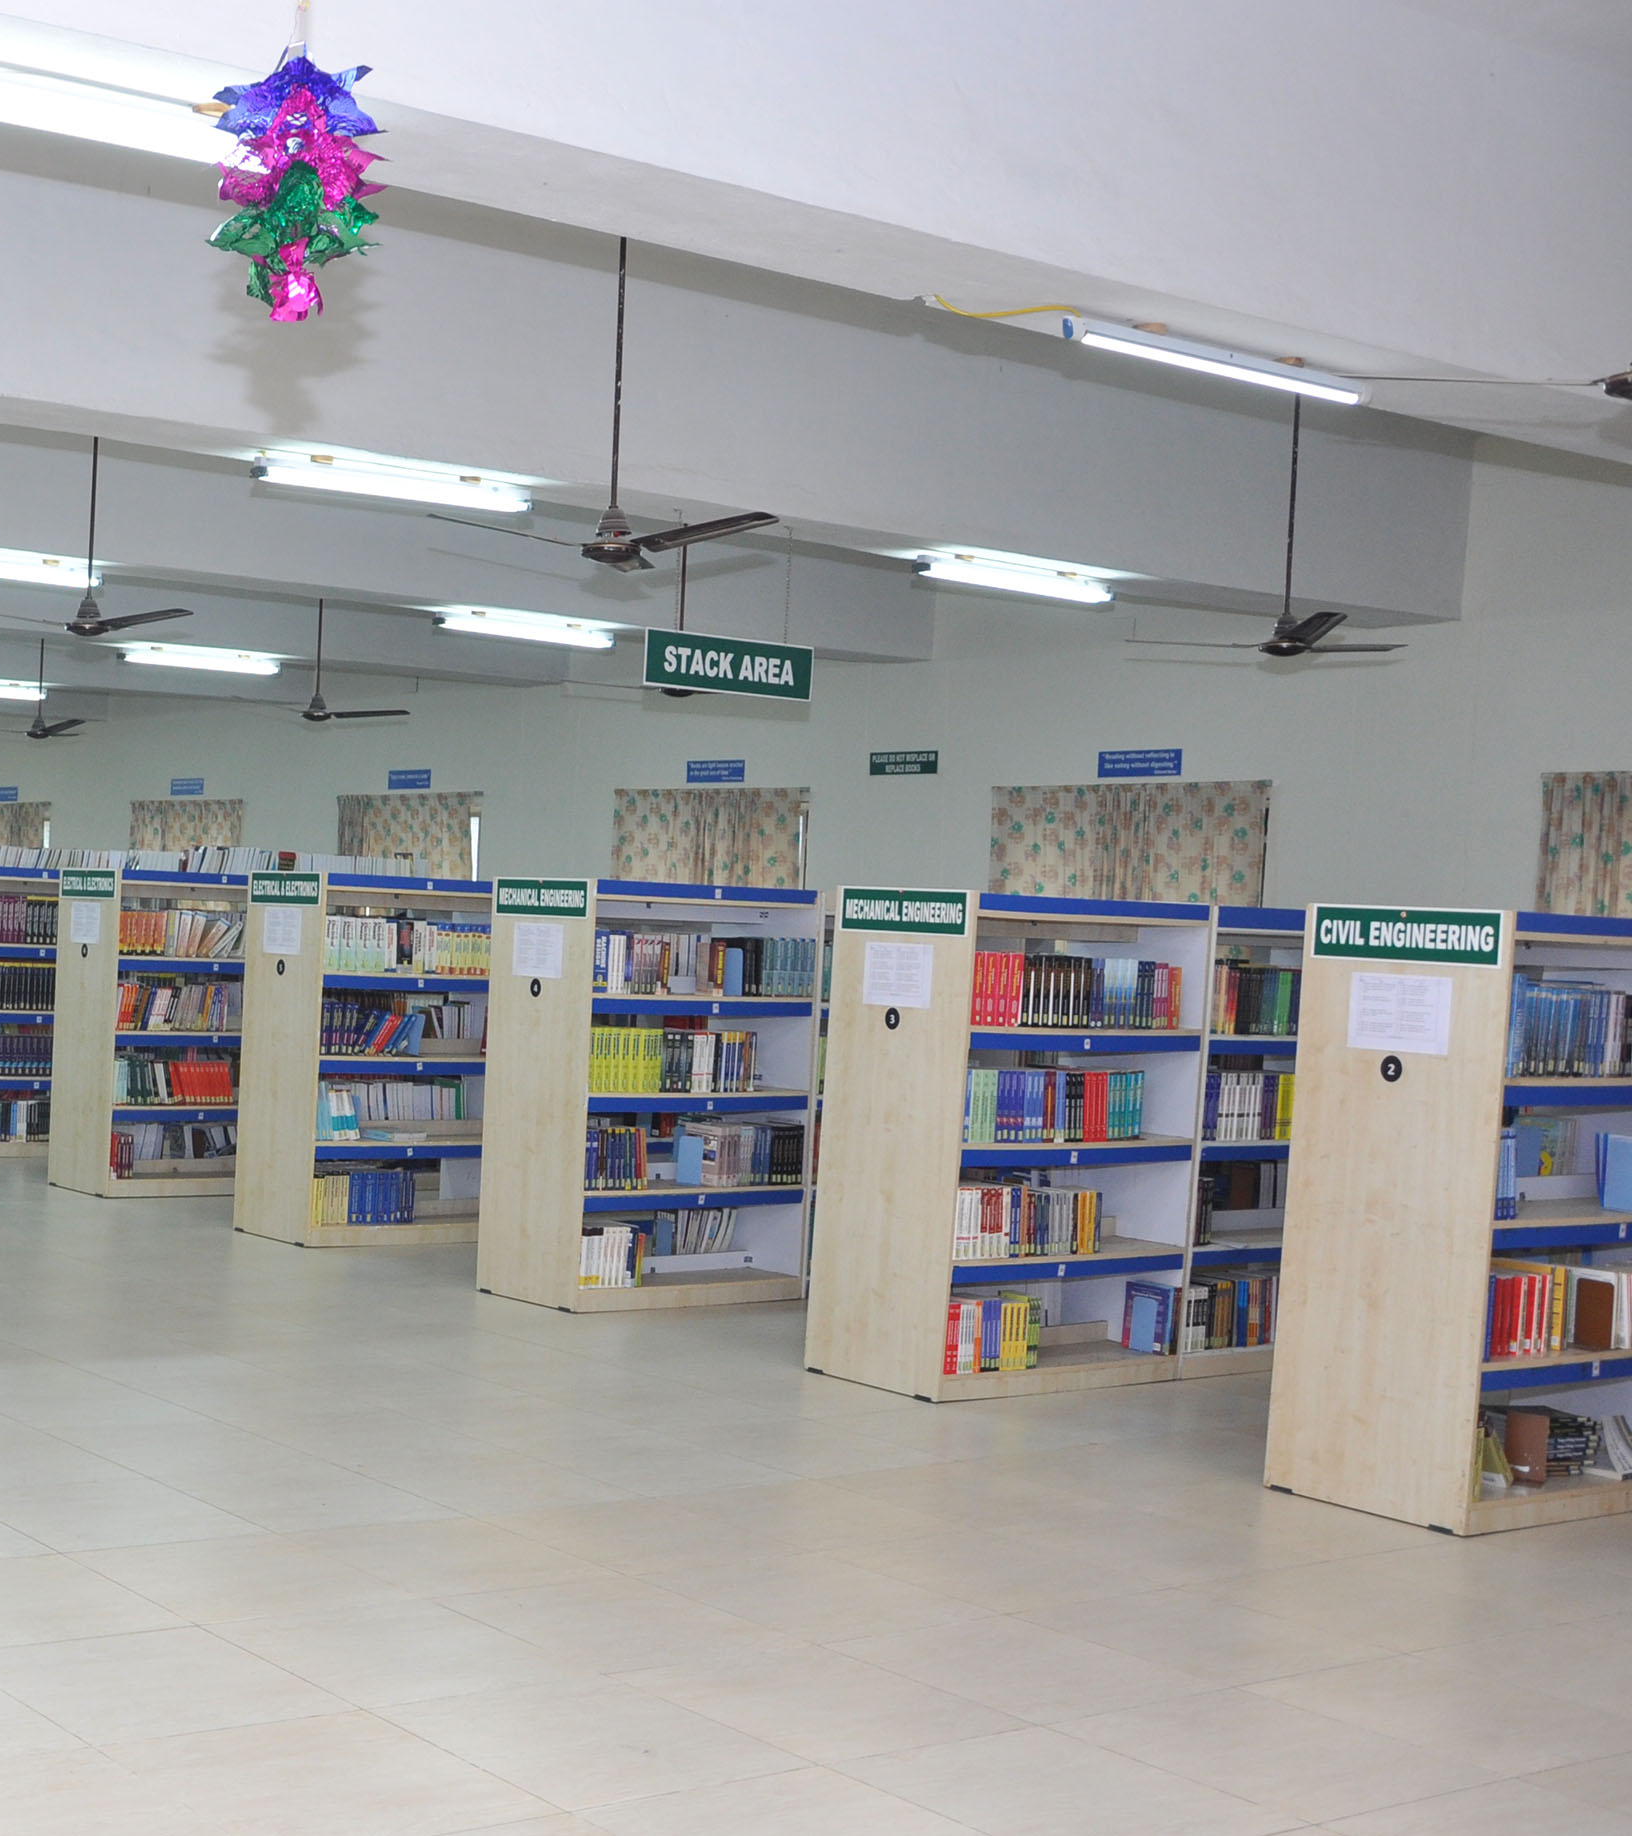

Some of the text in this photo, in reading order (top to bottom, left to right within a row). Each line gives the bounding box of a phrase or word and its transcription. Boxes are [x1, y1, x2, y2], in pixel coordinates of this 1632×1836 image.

[663, 645, 795, 686] STACK AREA
[253, 880, 318, 897] ELECTRICAL & ELECTRONICS
[499, 887, 585, 908] MECHANICAL ENGINEERING
[845, 898, 963, 925] MECHANICAL ENGINEERING
[1320, 919, 1495, 952] CIVIL ENGINEERING
[533, 984, 538, 992] 4
[889, 1014, 895, 1024] 3
[1387, 1063, 1395, 1075] 2
